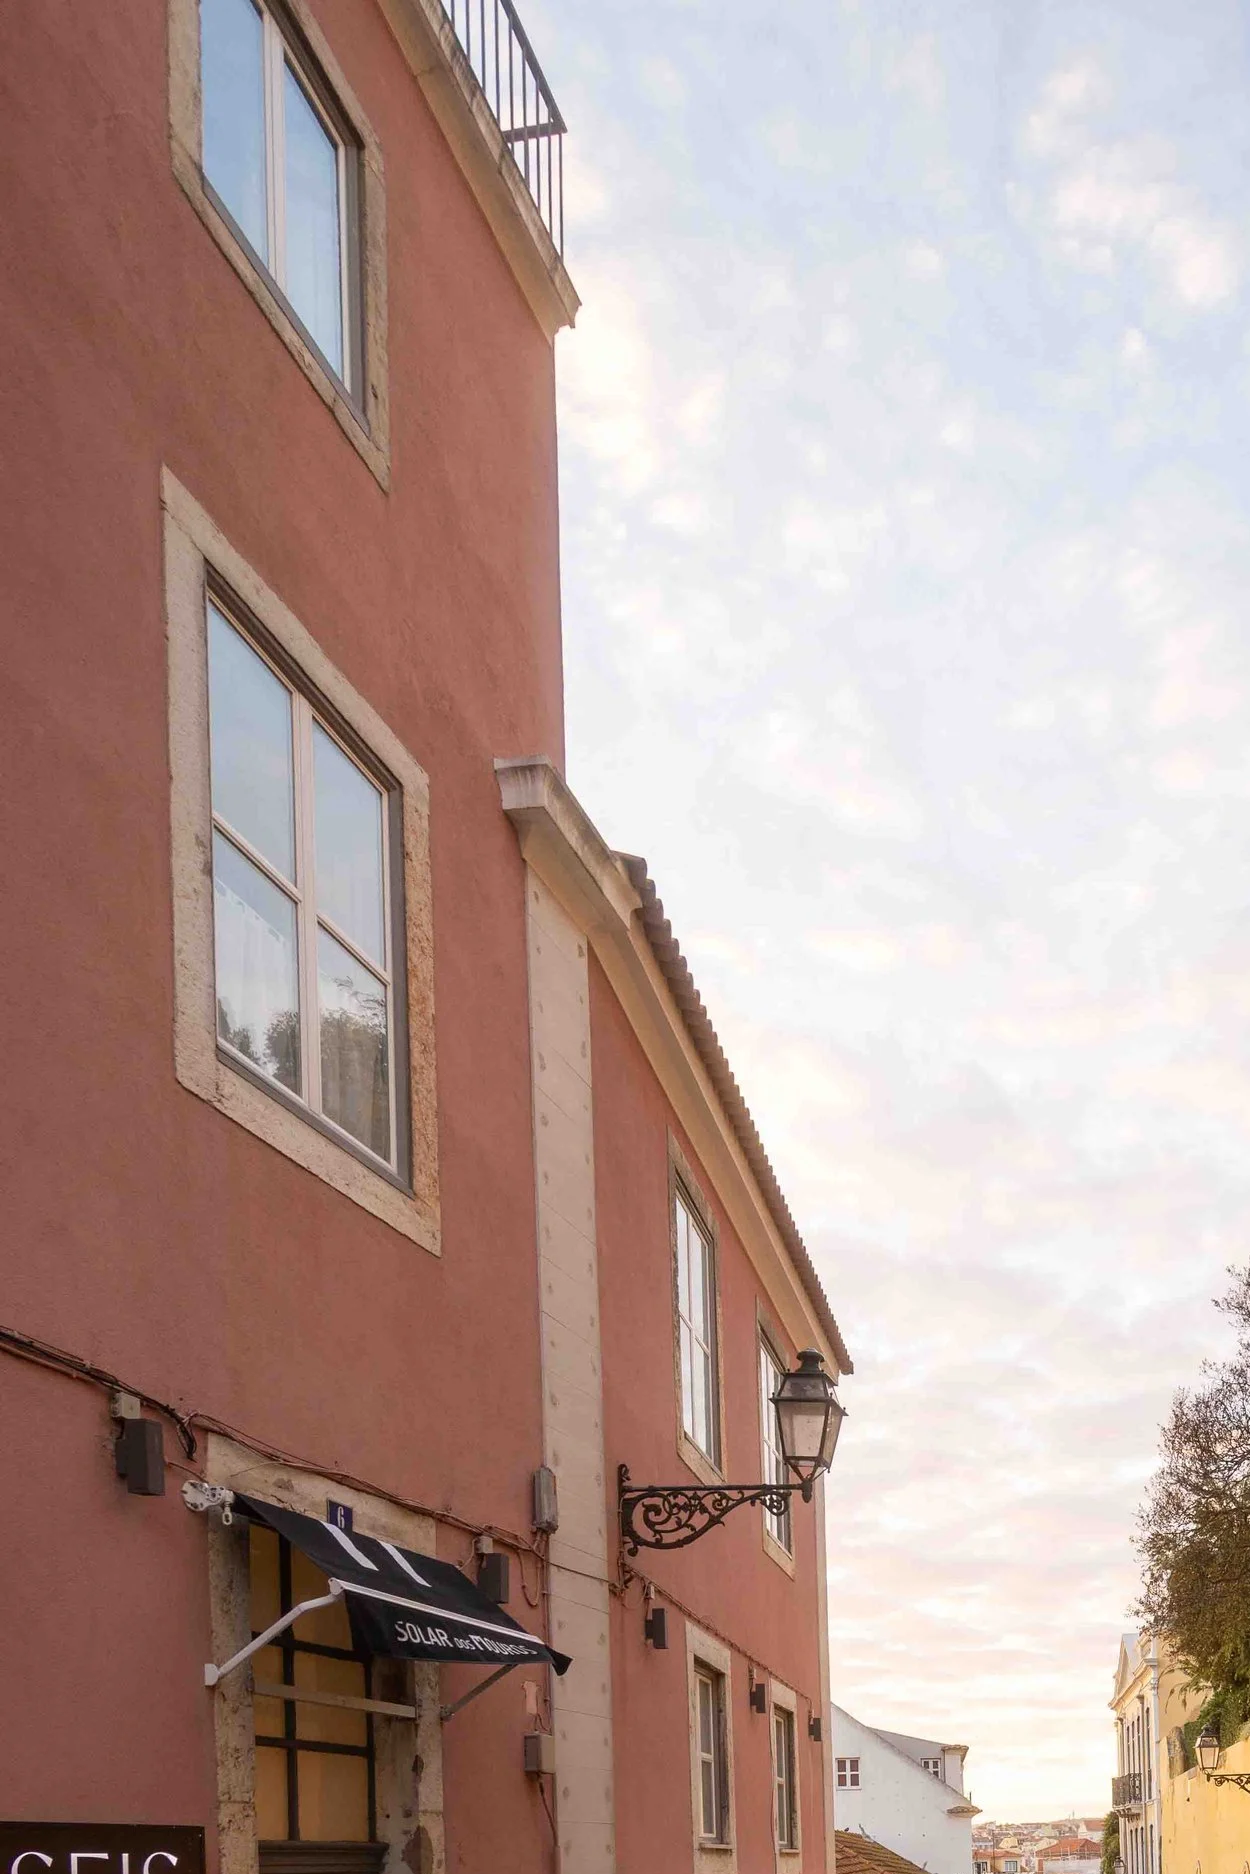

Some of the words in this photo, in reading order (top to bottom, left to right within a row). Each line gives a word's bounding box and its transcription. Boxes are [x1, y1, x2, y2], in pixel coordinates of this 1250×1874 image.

[337, 1506, 345, 1529] 6
[394, 1620, 454, 1648] SOLAR
[453, 1637, 476, 1651] DOS
[468, 1634, 538, 1656] MOUROS
